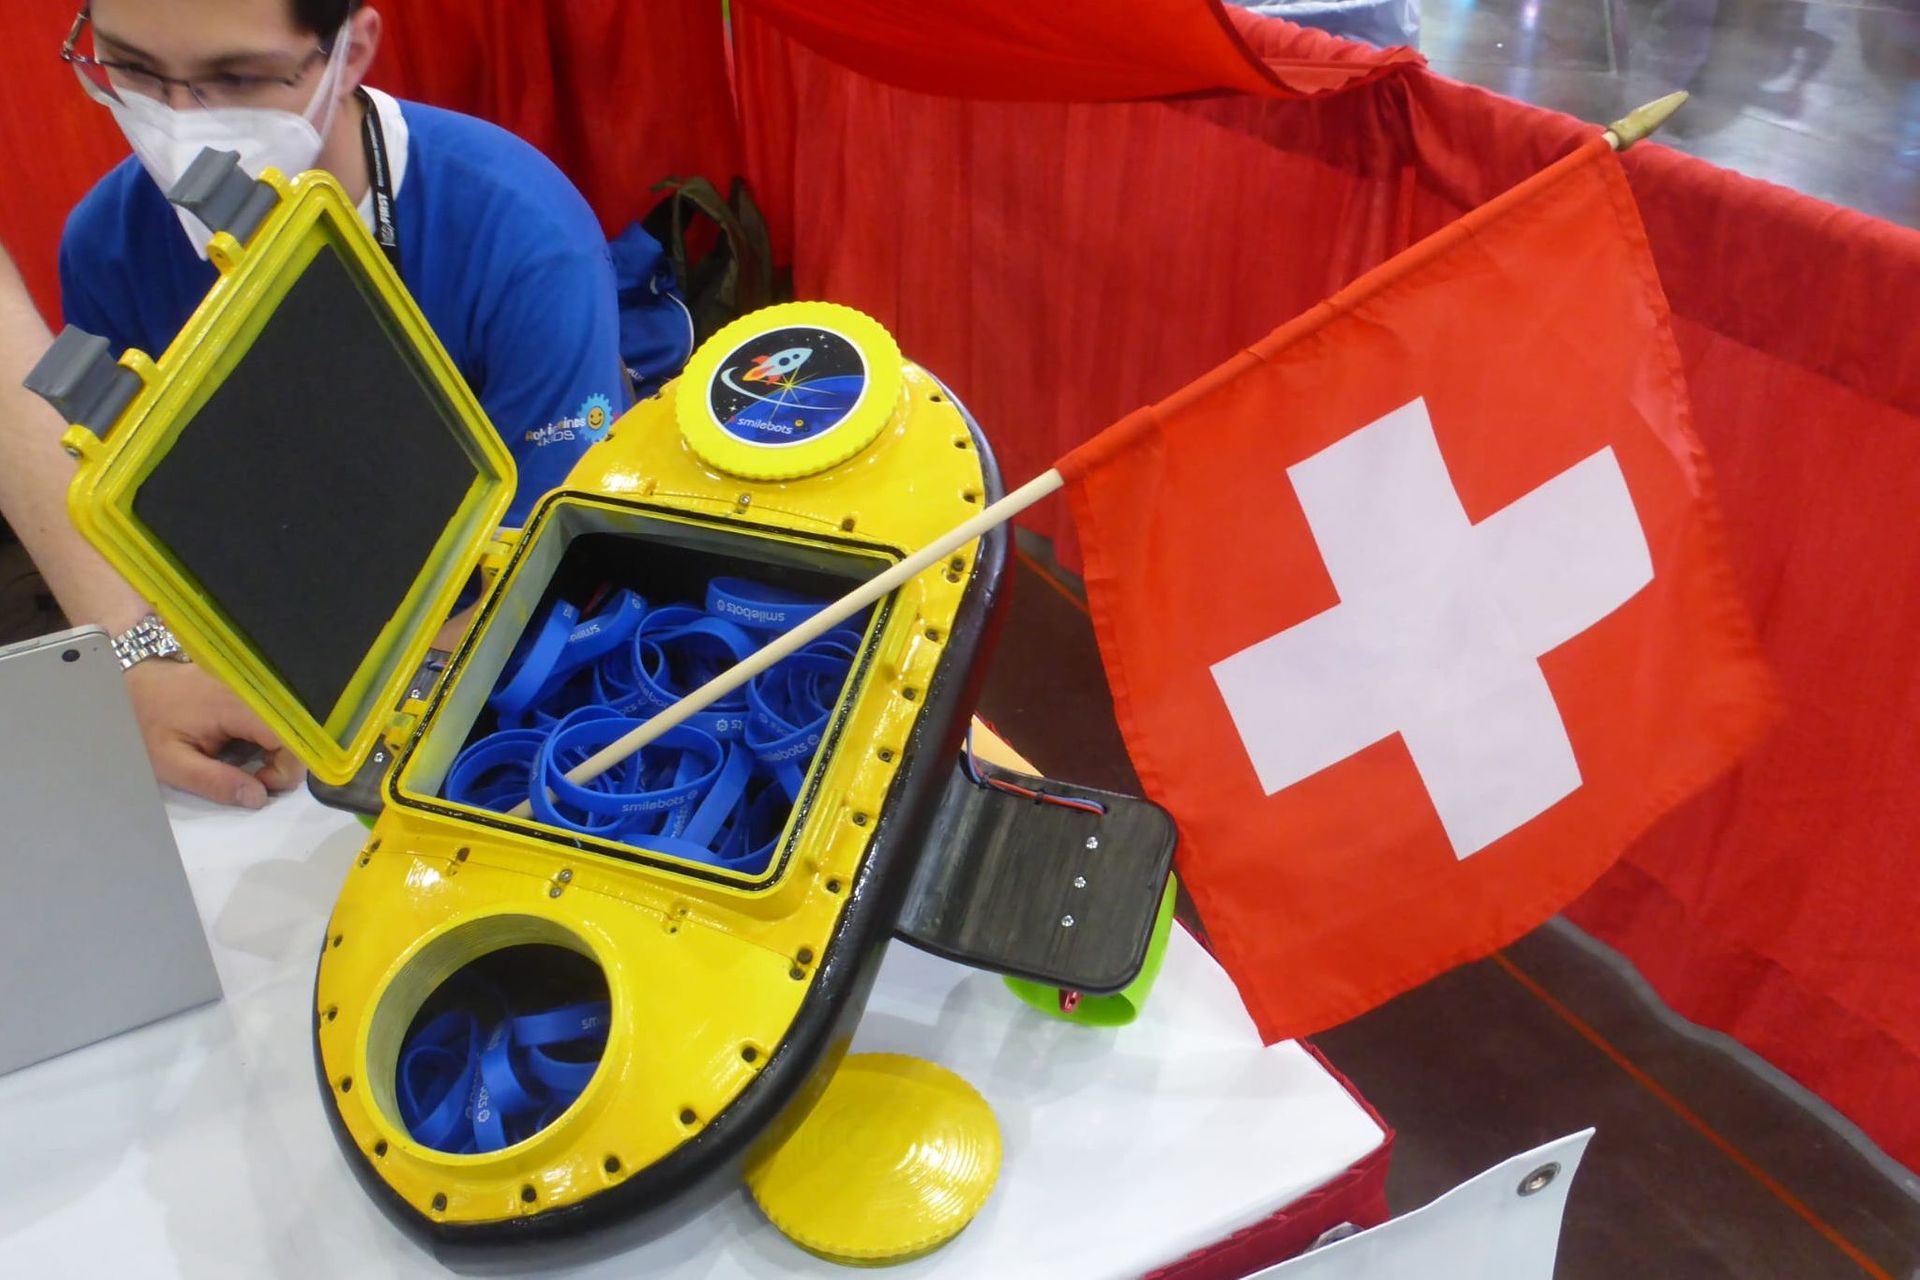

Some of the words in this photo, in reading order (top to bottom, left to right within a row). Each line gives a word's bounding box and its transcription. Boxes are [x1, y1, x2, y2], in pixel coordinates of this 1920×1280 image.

[737, 418, 792, 434] smilebots
[726, 602, 785, 622] smilebots
[621, 795, 685, 813] smilebots
